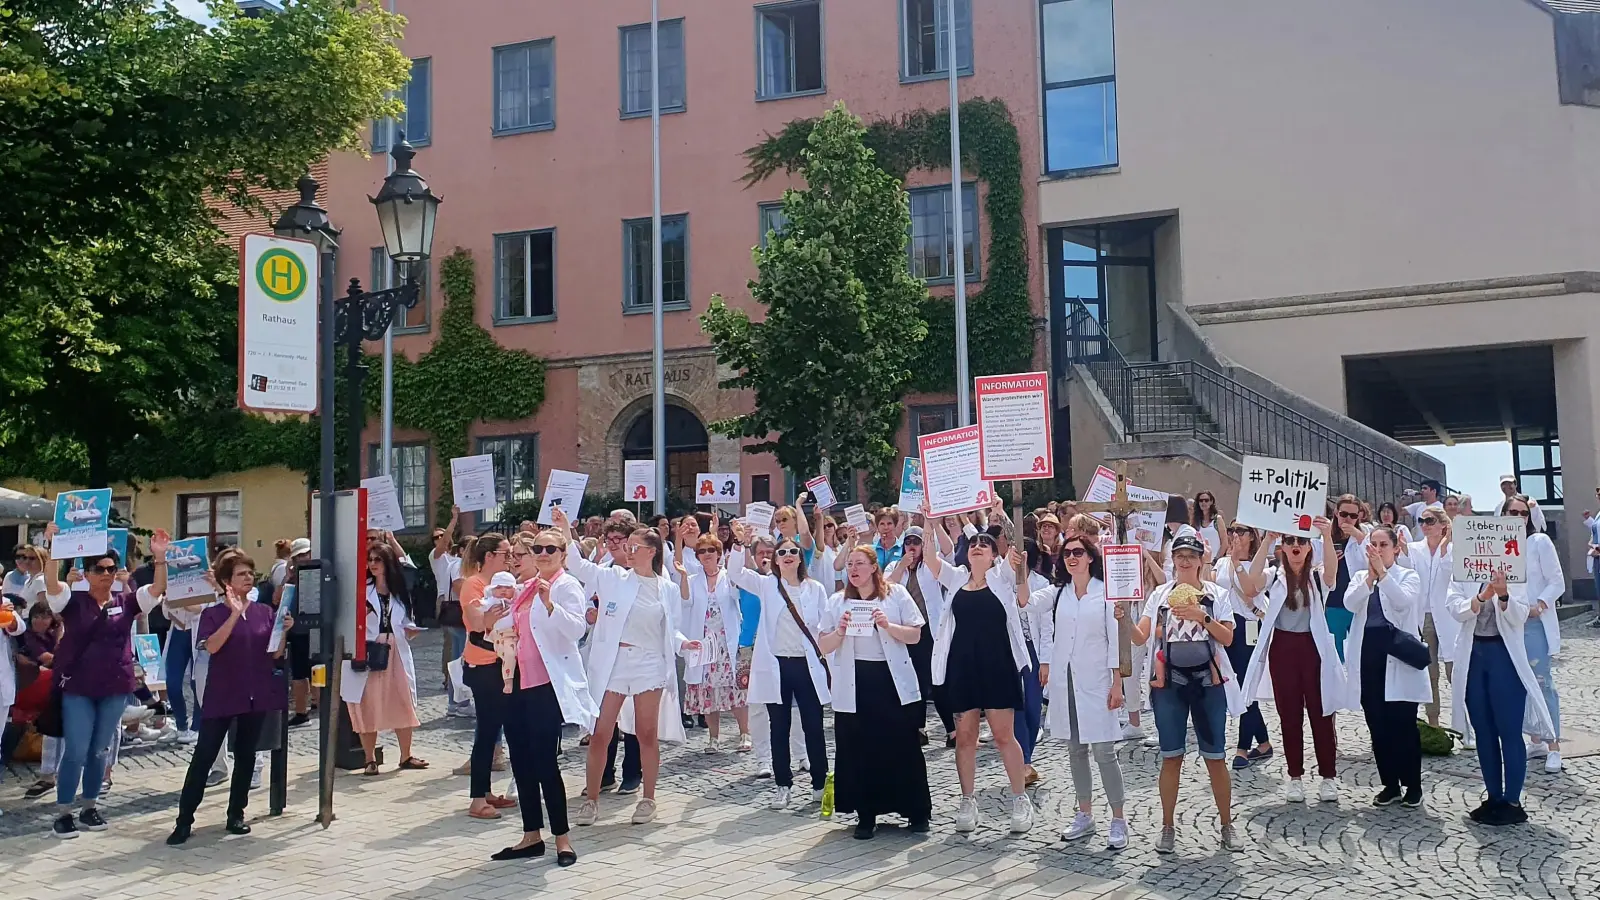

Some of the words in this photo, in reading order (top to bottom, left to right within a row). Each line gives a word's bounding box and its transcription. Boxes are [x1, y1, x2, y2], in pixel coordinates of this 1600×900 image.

[271, 259, 292, 290] H
[262, 314, 297, 325] Rathaus
[626, 369, 690, 386] RATAUS
[981, 379, 1042, 391] INFORMATION
[1249, 468, 1326, 491] #Politik-
[1254, 490, 1306, 513] unfall
[1506, 522, 1522, 531] wir
[1475, 540, 1494, 554] IHR
[1464, 558, 1494, 572] Rettet
[1498, 561, 1512, 572] die
[1467, 569, 1518, 582] Apotken
